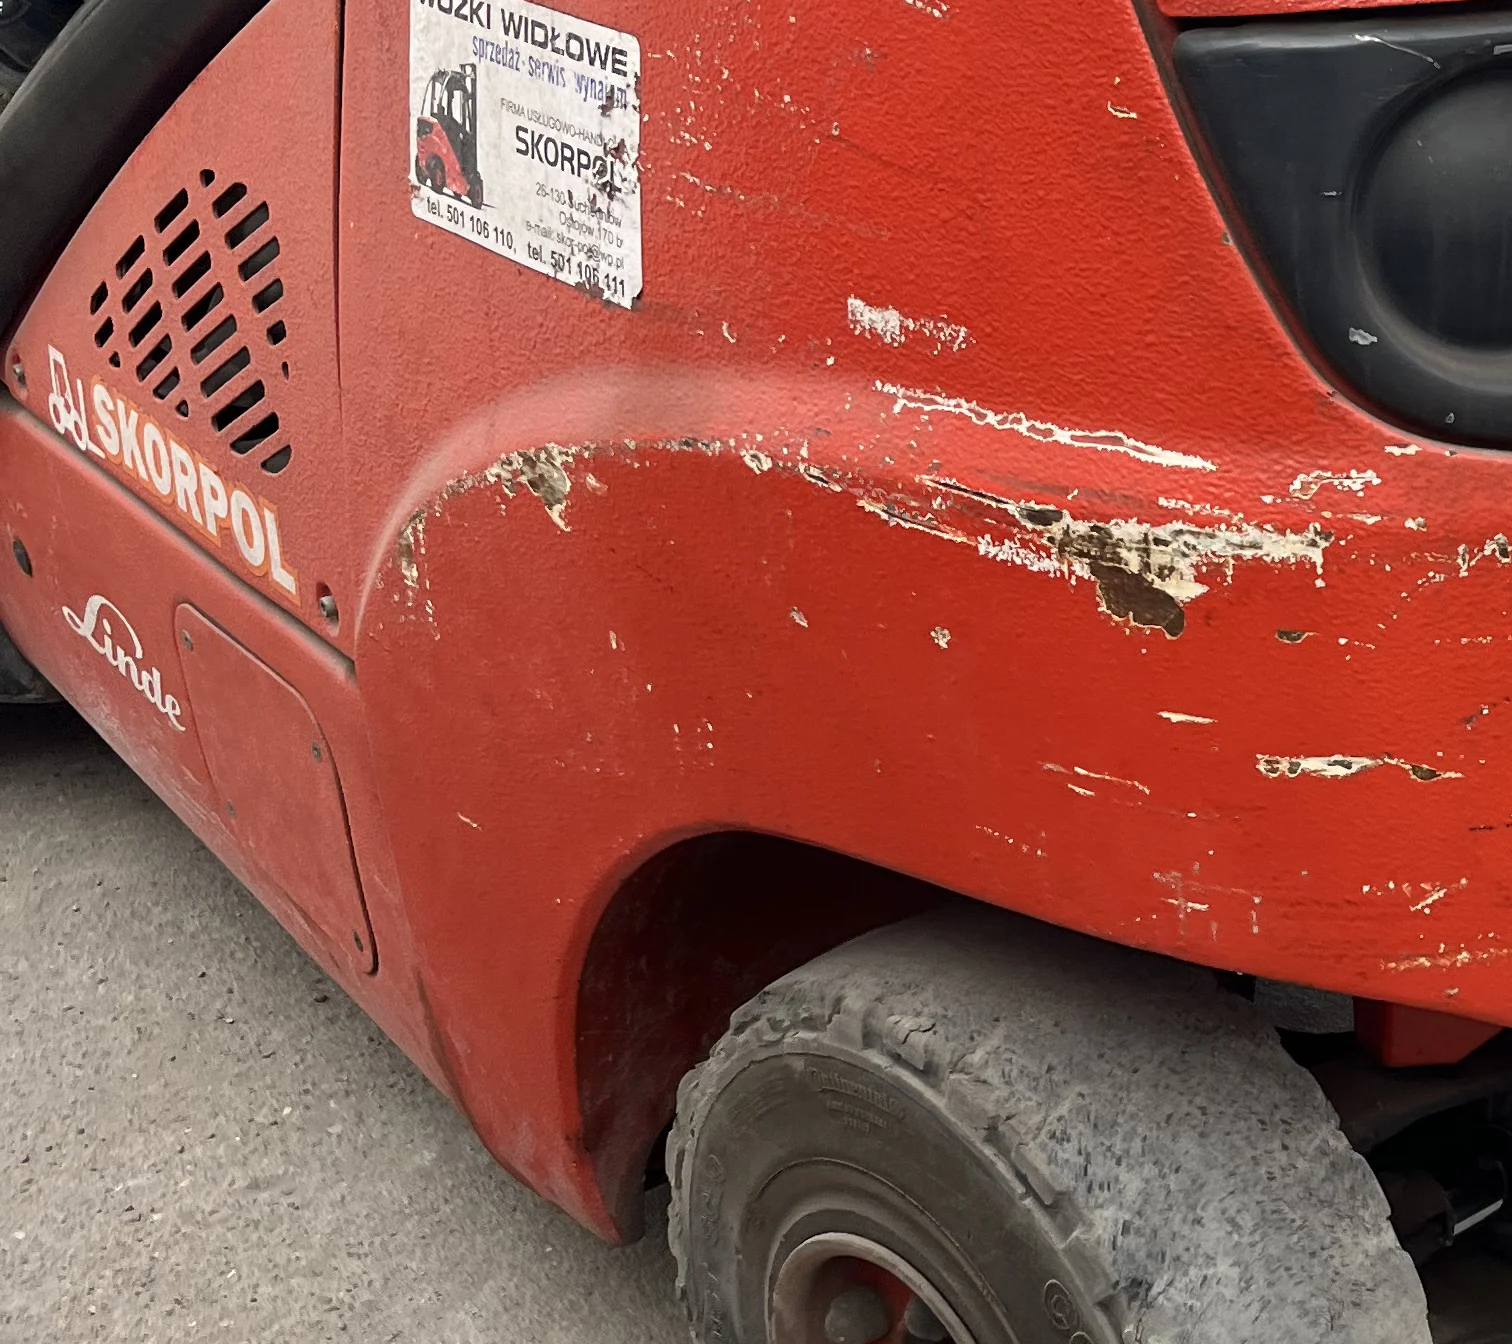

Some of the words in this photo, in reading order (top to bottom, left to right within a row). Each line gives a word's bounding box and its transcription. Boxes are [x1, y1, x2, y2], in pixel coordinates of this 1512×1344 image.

[472, 34, 521, 73] sprzedaż
[527, 55, 567, 88] serwis
[573, 71, 628, 109] wynajm
[500, 7, 629, 77] WIDŁOWE
[499, 97, 527, 118] FIRMA
[515, 124, 622, 194] SKORPOL
[426, 196, 444, 218] tel.
[446, 204, 466, 229] 501
[469, 215, 490, 240] 106
[493, 227, 517, 254] 110,
[527, 241, 546, 265] tel.
[550, 250, 572, 275] 501
[577, 261, 600, 285] 106
[604, 273, 625, 298] 111
[92, 384, 297, 595] SKORPOL
[61, 594, 187, 732] Linde
